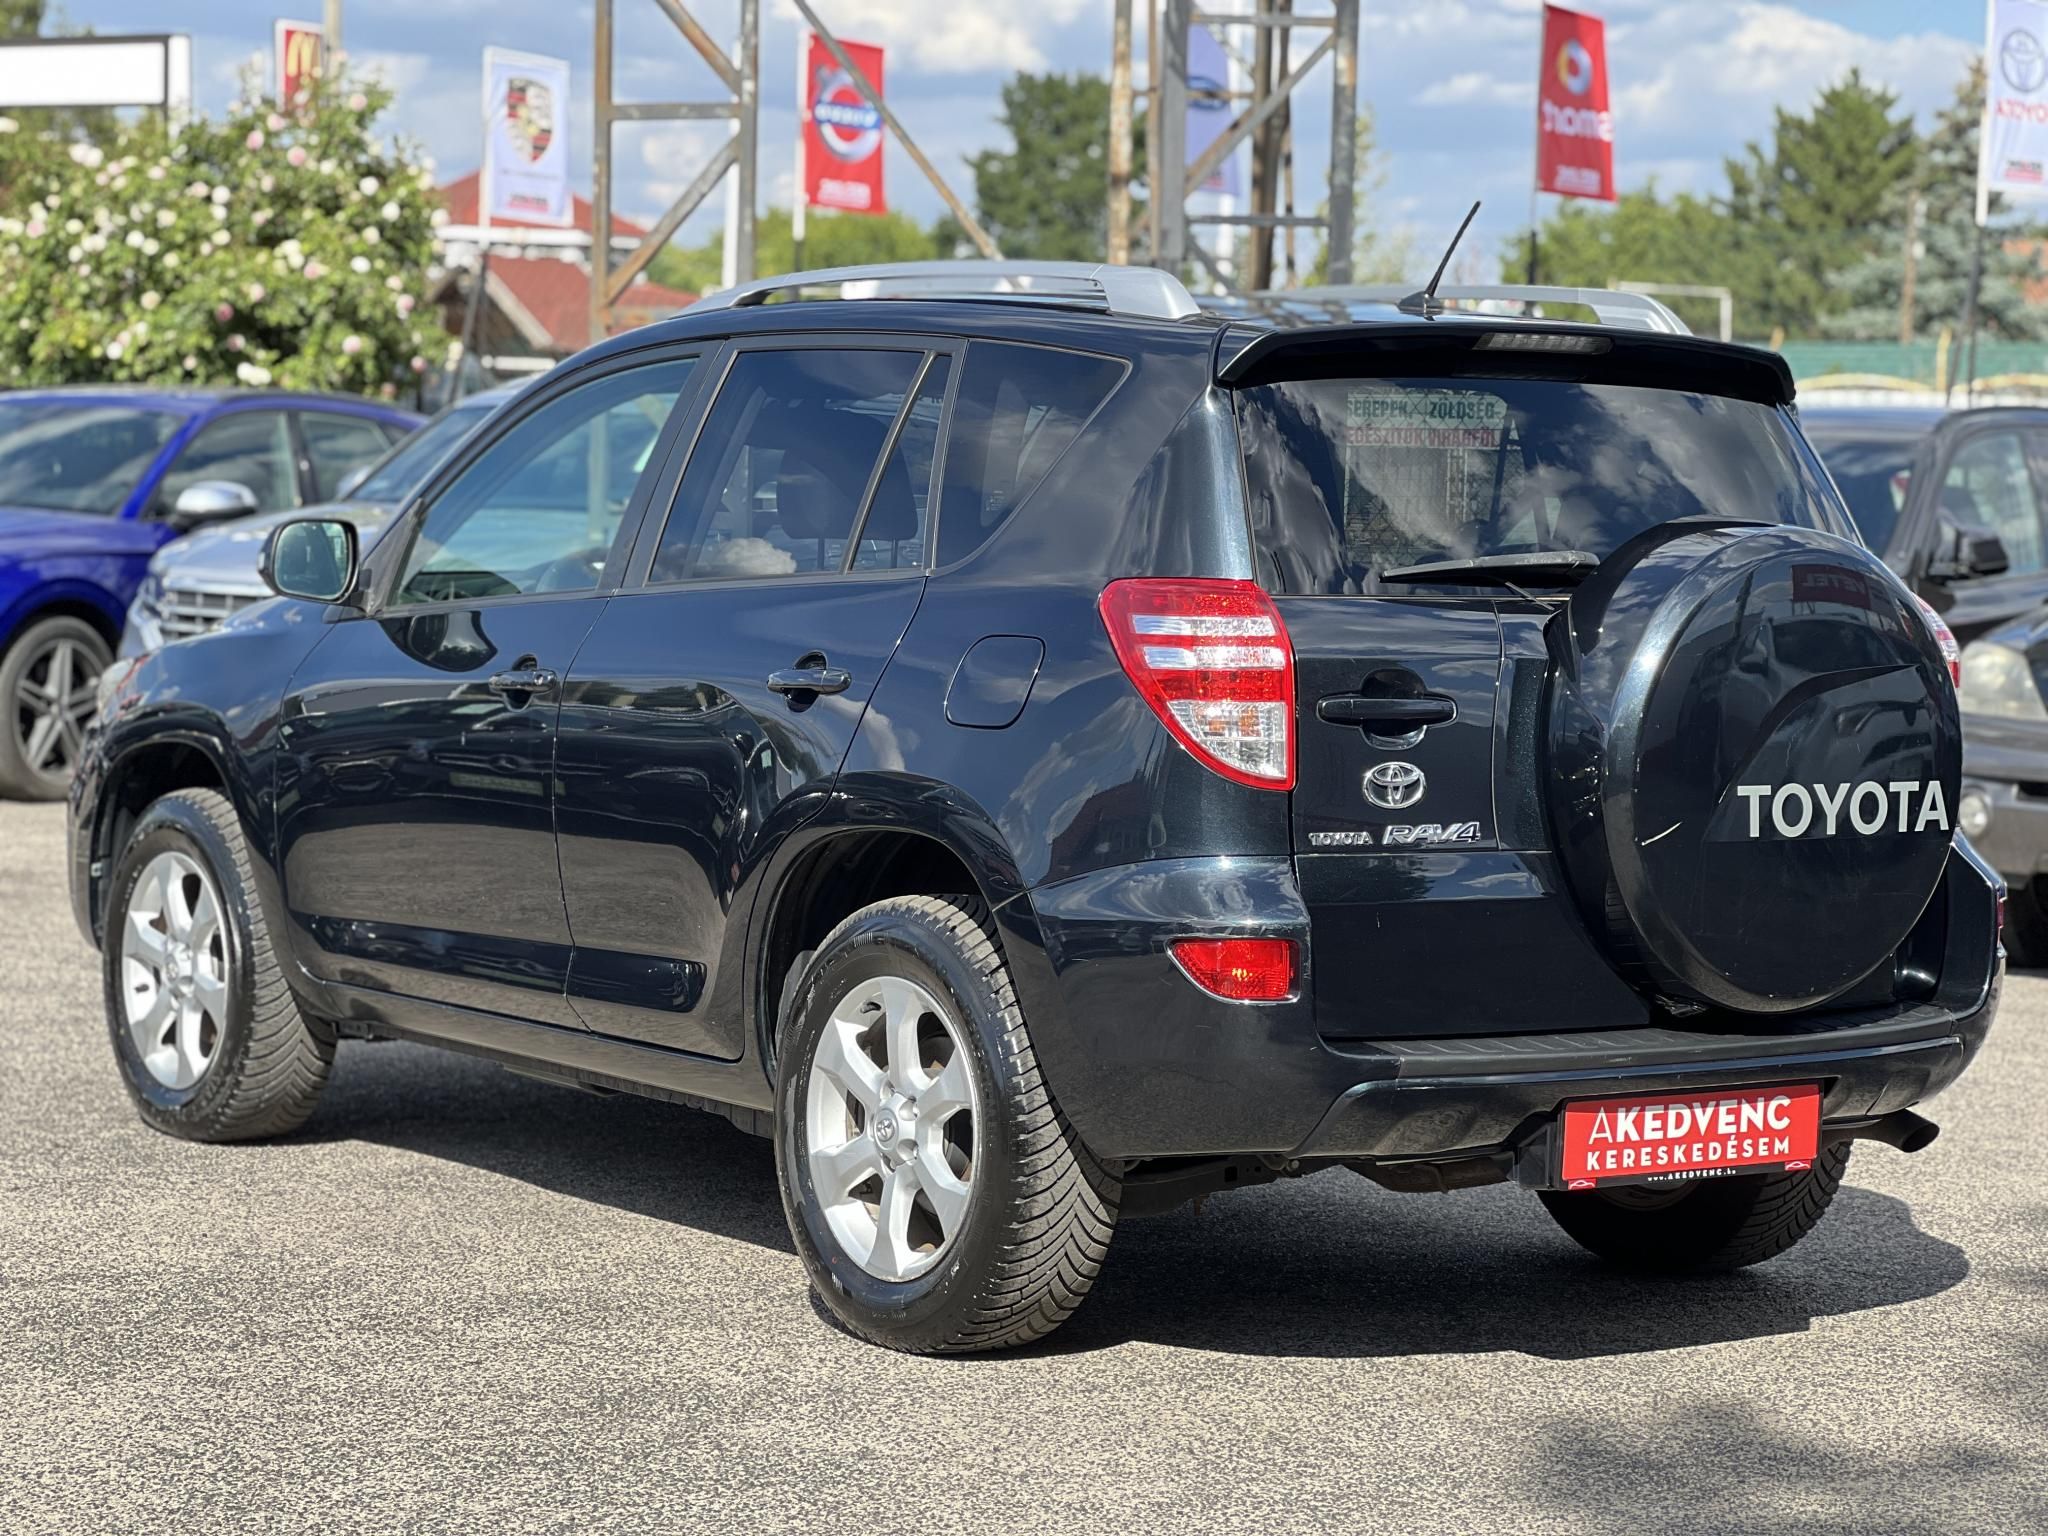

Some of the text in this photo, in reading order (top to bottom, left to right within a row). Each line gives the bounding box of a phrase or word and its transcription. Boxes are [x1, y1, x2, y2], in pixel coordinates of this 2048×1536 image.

[1737, 780, 1949, 838] TOYOTA
[1308, 821, 1481, 846] TOYOTA RAV4
[1586, 1135, 1790, 1171] KERESKEDÉSEM
